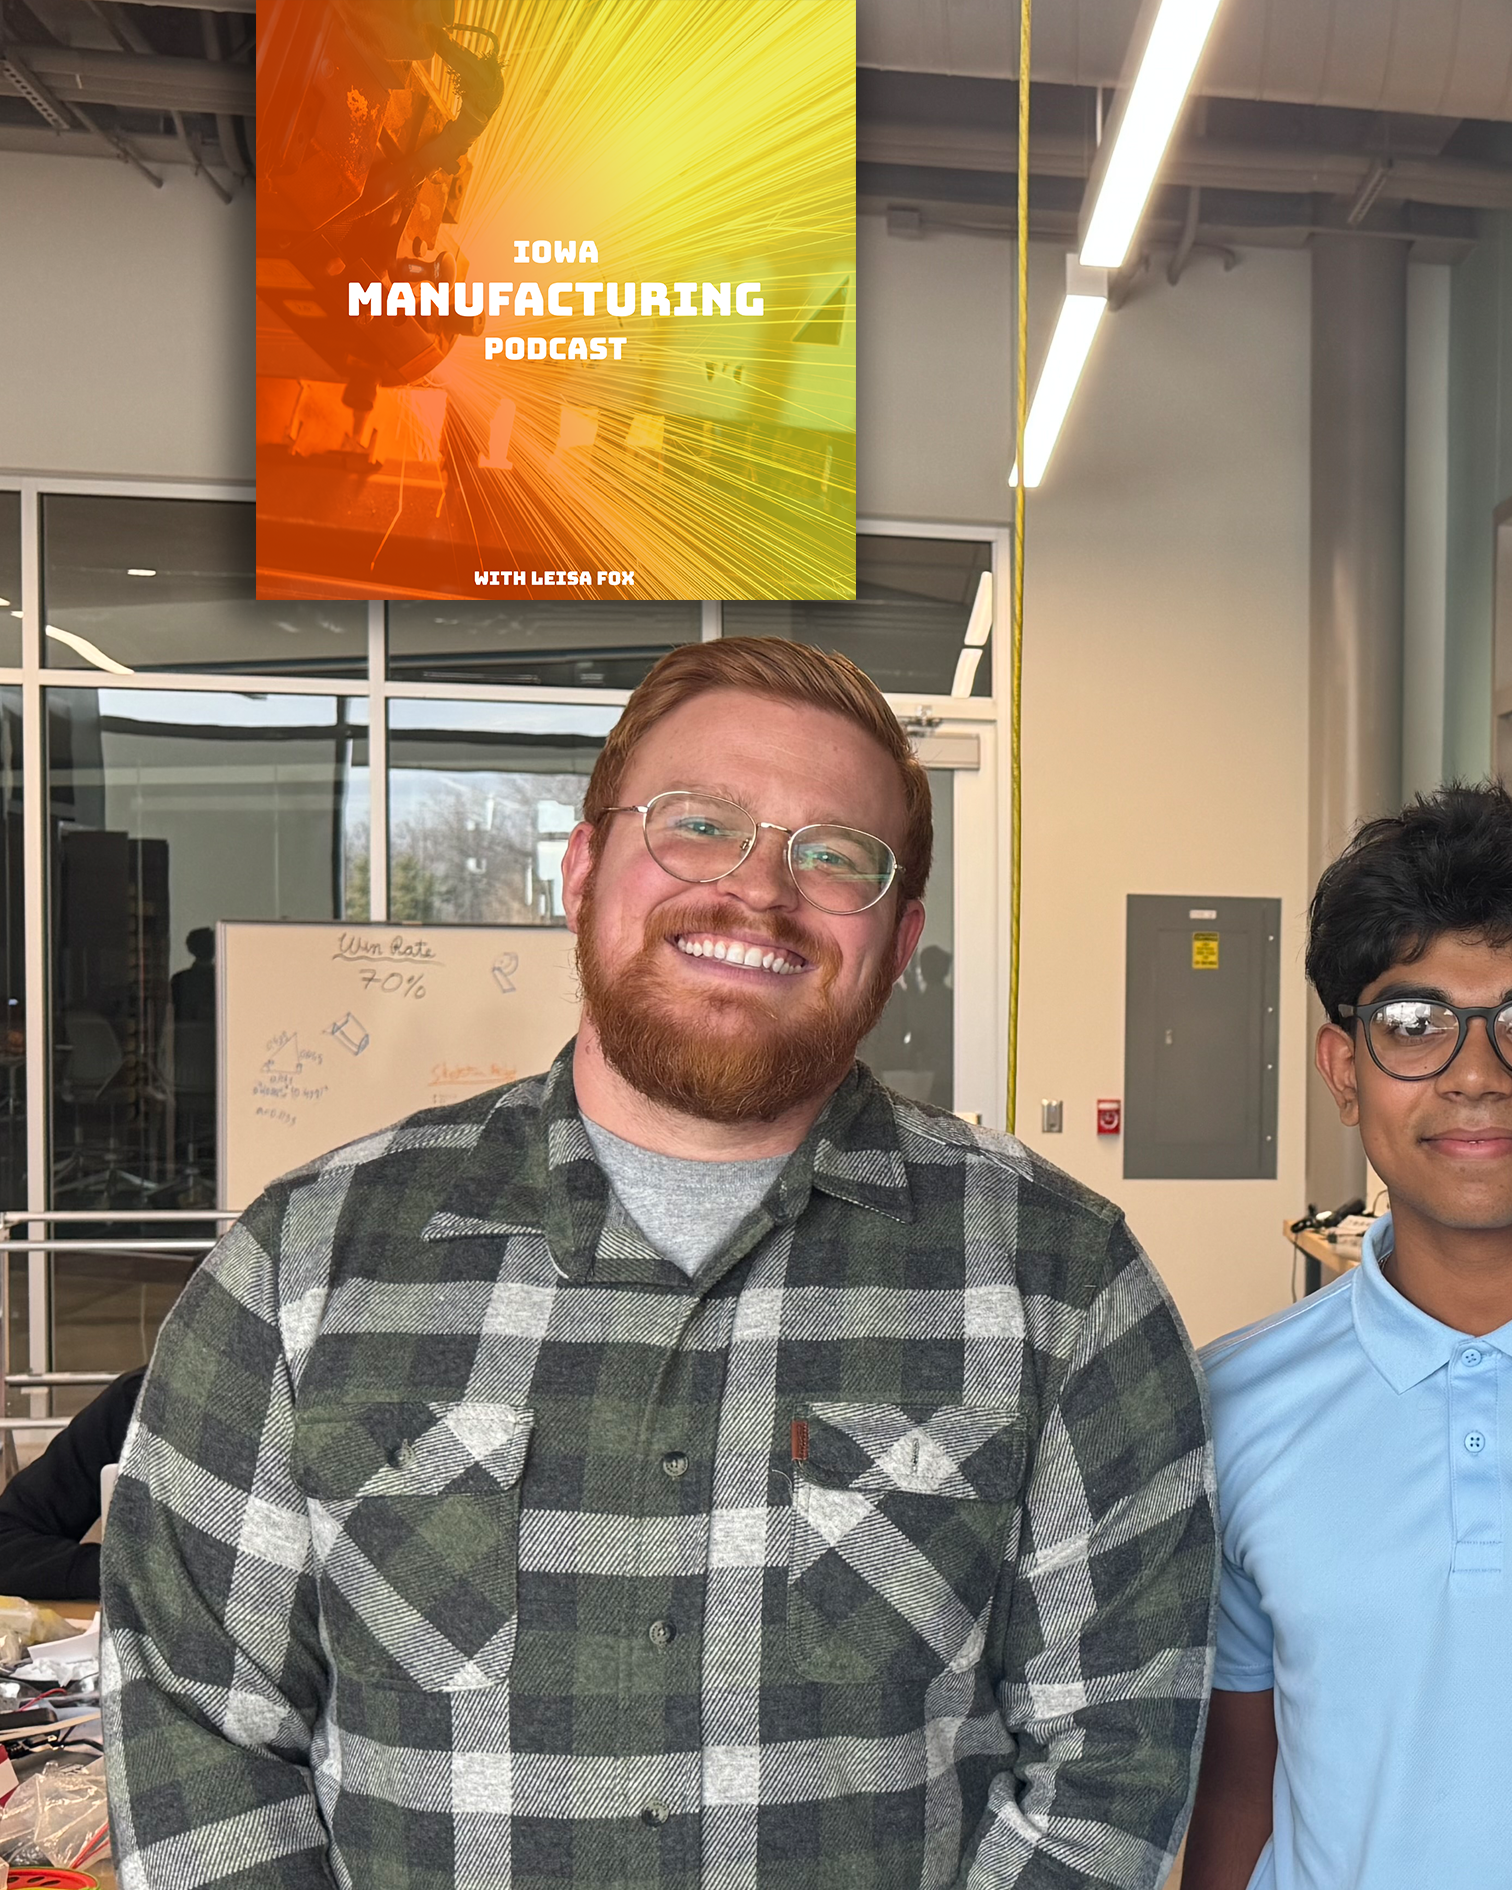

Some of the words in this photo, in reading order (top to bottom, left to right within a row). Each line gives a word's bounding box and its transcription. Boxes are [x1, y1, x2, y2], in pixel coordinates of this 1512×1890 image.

[338, 932, 382, 956] Win
[390, 935, 436, 959] Rate
[359, 968, 427, 1000] 70%
